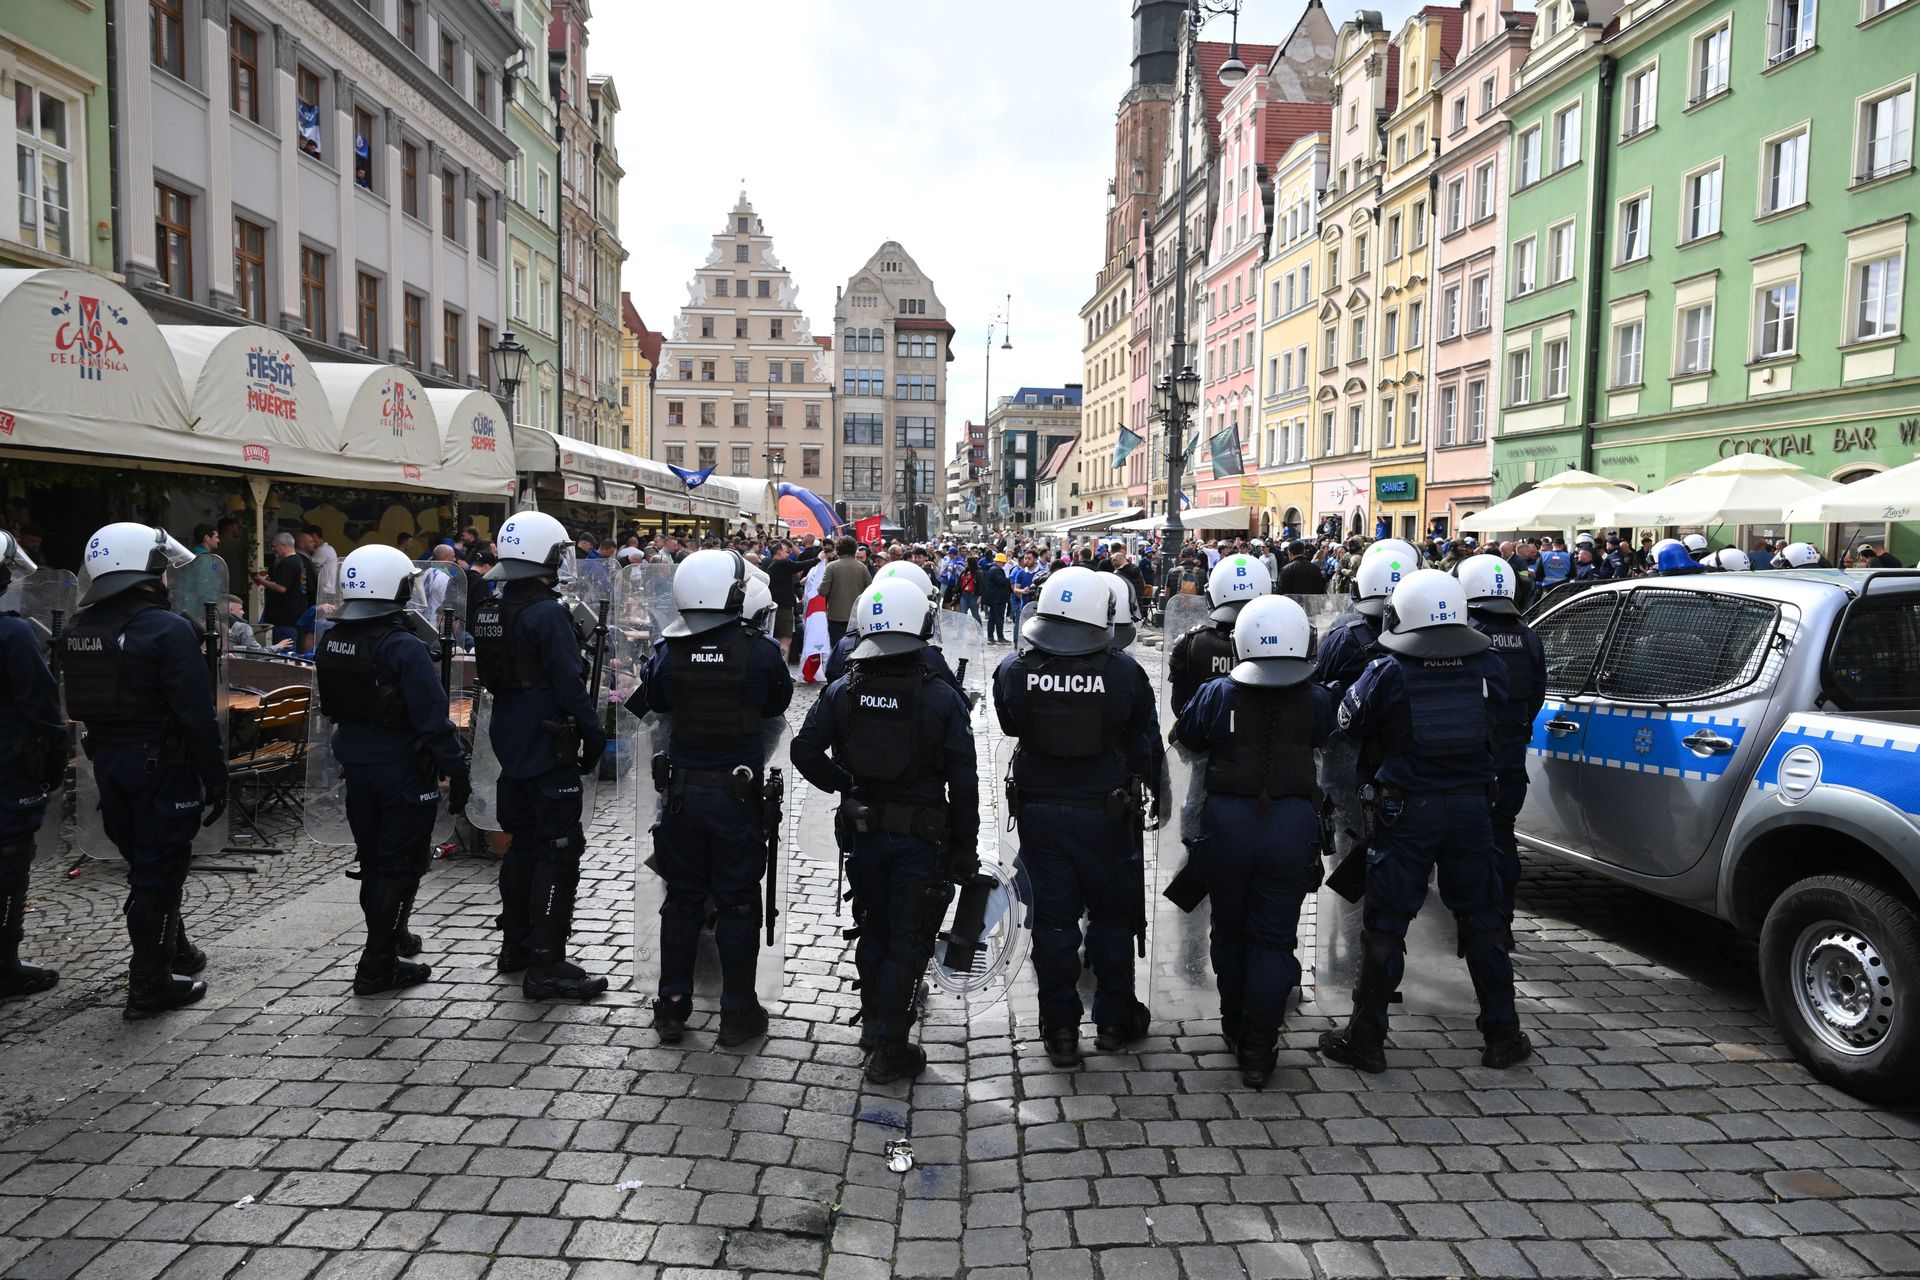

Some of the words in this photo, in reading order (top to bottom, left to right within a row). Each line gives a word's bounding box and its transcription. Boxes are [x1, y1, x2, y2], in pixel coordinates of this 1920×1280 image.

[56, 320, 124, 358] CASA
[50, 353, 67, 364] DE
[70, 354, 85, 366] LA
[248, 352, 293, 387] FIESTA
[248, 390, 297, 420] MUERTE
[382, 399, 414, 420] CASA
[473, 416, 494, 437] CUBA
[471, 436, 496, 452] SIEMPRE
[1718, 433, 1814, 459] COCKTAIL
[1833, 426, 1877, 452] BAR
[1899, 418, 1920, 446] W
[1381, 481, 1406, 492] CHANGE
[506, 523, 515, 532] G
[90, 538, 99, 549] G
[347, 567, 356, 578] G
[1236, 567, 1246, 577] B
[1391, 572, 1401, 582] B
[1495, 574, 1504, 583] B
[1233, 583, 1253, 591] I-D-1
[1060, 590, 1073, 603] B
[872, 603, 883, 615] B
[1439, 601, 1446, 609] B
[477, 613, 499, 623] POLICJA
[1430, 611, 1456, 621] I-B-1
[869, 621, 890, 631] I-B-1
[68, 637, 103, 651] POLICJA
[1260, 636, 1278, 645] XIII
[1492, 634, 1523, 647] POLICJA
[327, 640, 356, 655] POLICJA
[691, 653, 724, 662] POLICJA
[1423, 658, 1463, 667] POLICJA
[1027, 673, 1106, 693] POLICJA
[860, 695, 898, 709] POLICJA
[545, 885, 555, 915] POLICJA
